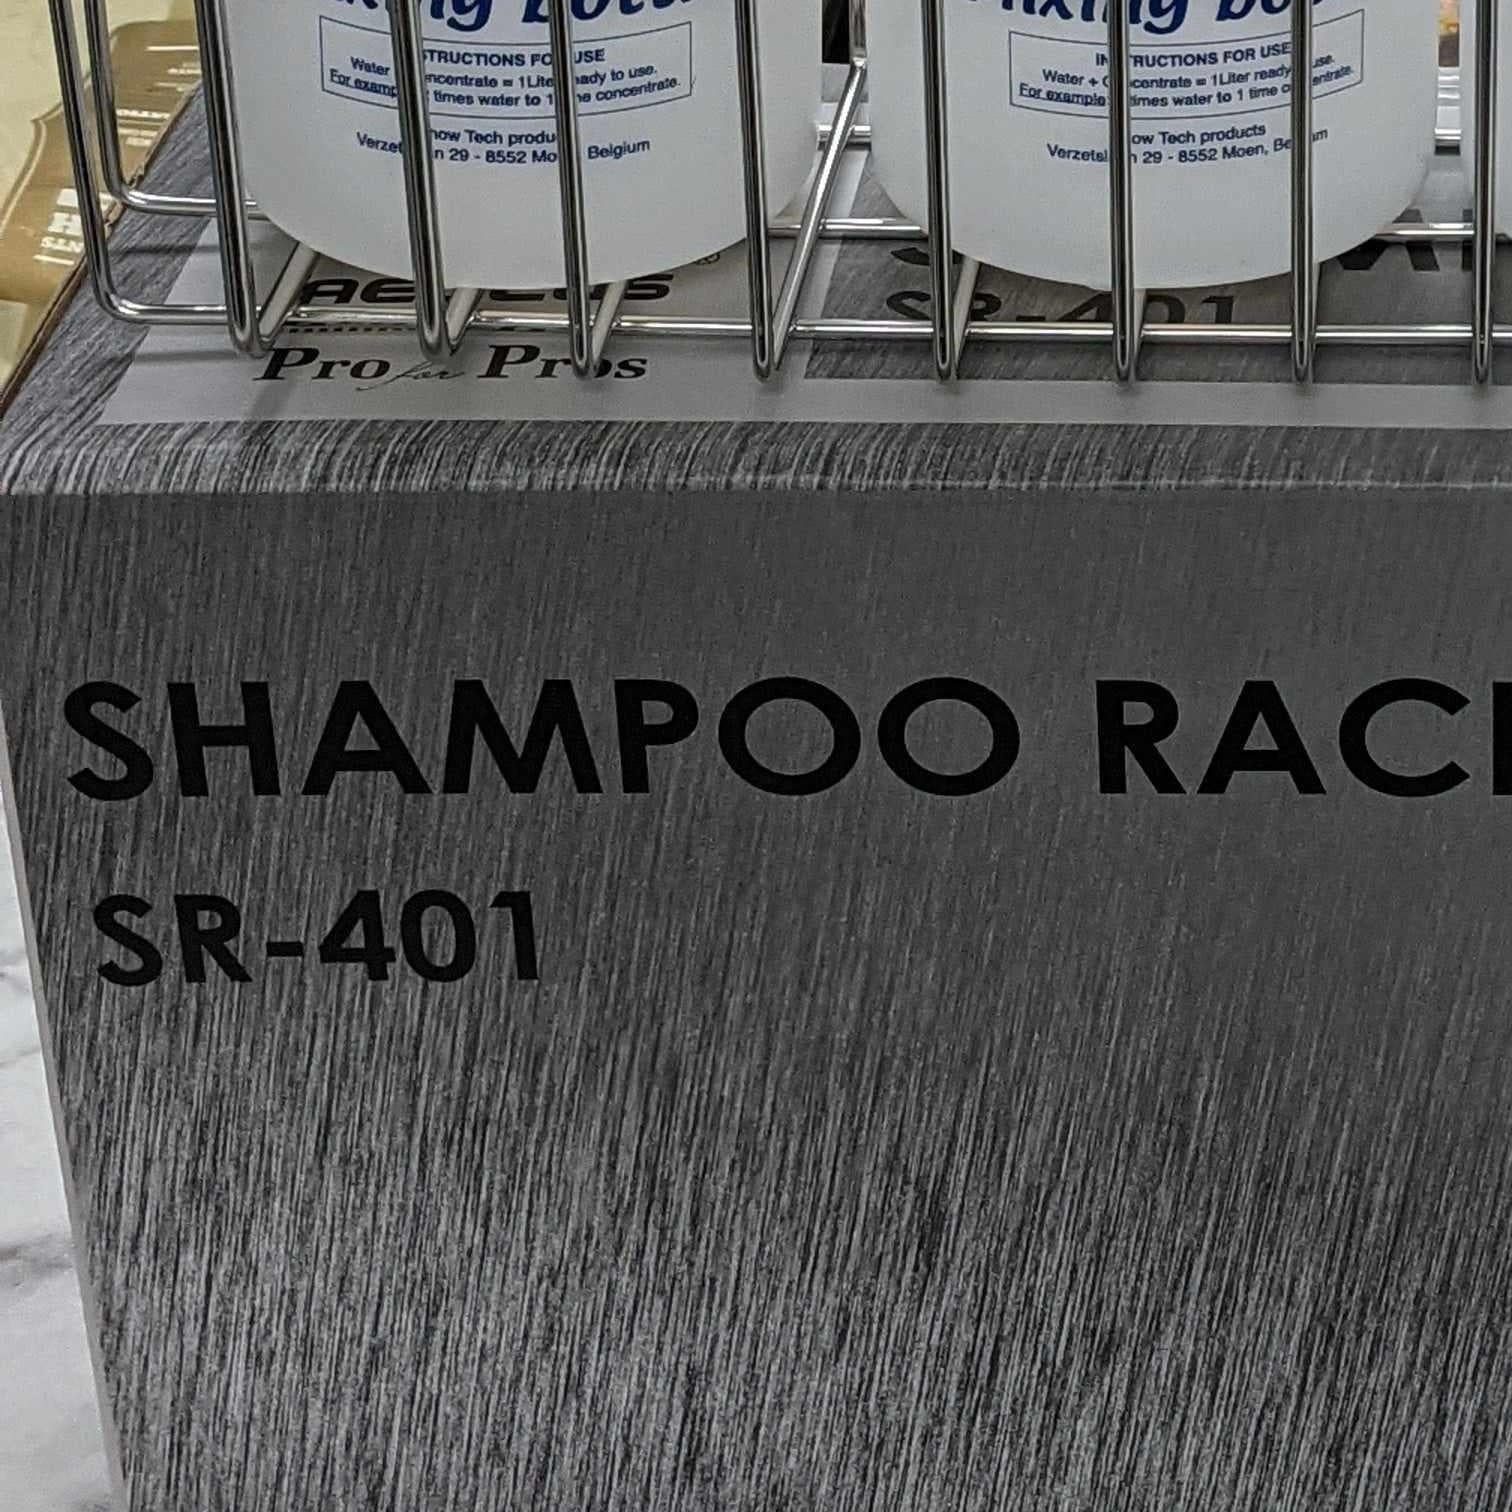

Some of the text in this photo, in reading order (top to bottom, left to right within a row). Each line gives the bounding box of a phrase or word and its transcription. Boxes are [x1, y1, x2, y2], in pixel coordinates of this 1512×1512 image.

[1223, 41, 1291, 64] FOR USE
[351, 56, 390, 75] Water
[611, 69, 624, 81] to
[1042, 69, 1084, 86] Water
[329, 68, 351, 85] For
[433, 90, 474, 105] times
[479, 93, 521, 106] water
[525, 94, 541, 106] to
[1019, 82, 1043, 99] For
[1173, 93, 1213, 106] water
[1217, 92, 1232, 103] to
[465, 129, 501, 144] Tech
[1158, 124, 1266, 146] Tech products
[449, 139, 650, 164] 29 8552 Belgium
[1142, 143, 1268, 163] 29 8552 Moen,
[253, 348, 391, 381] Pro
[62, 673, 1022, 803] SHAMPOO
[91, 888, 541, 989] SR-401
